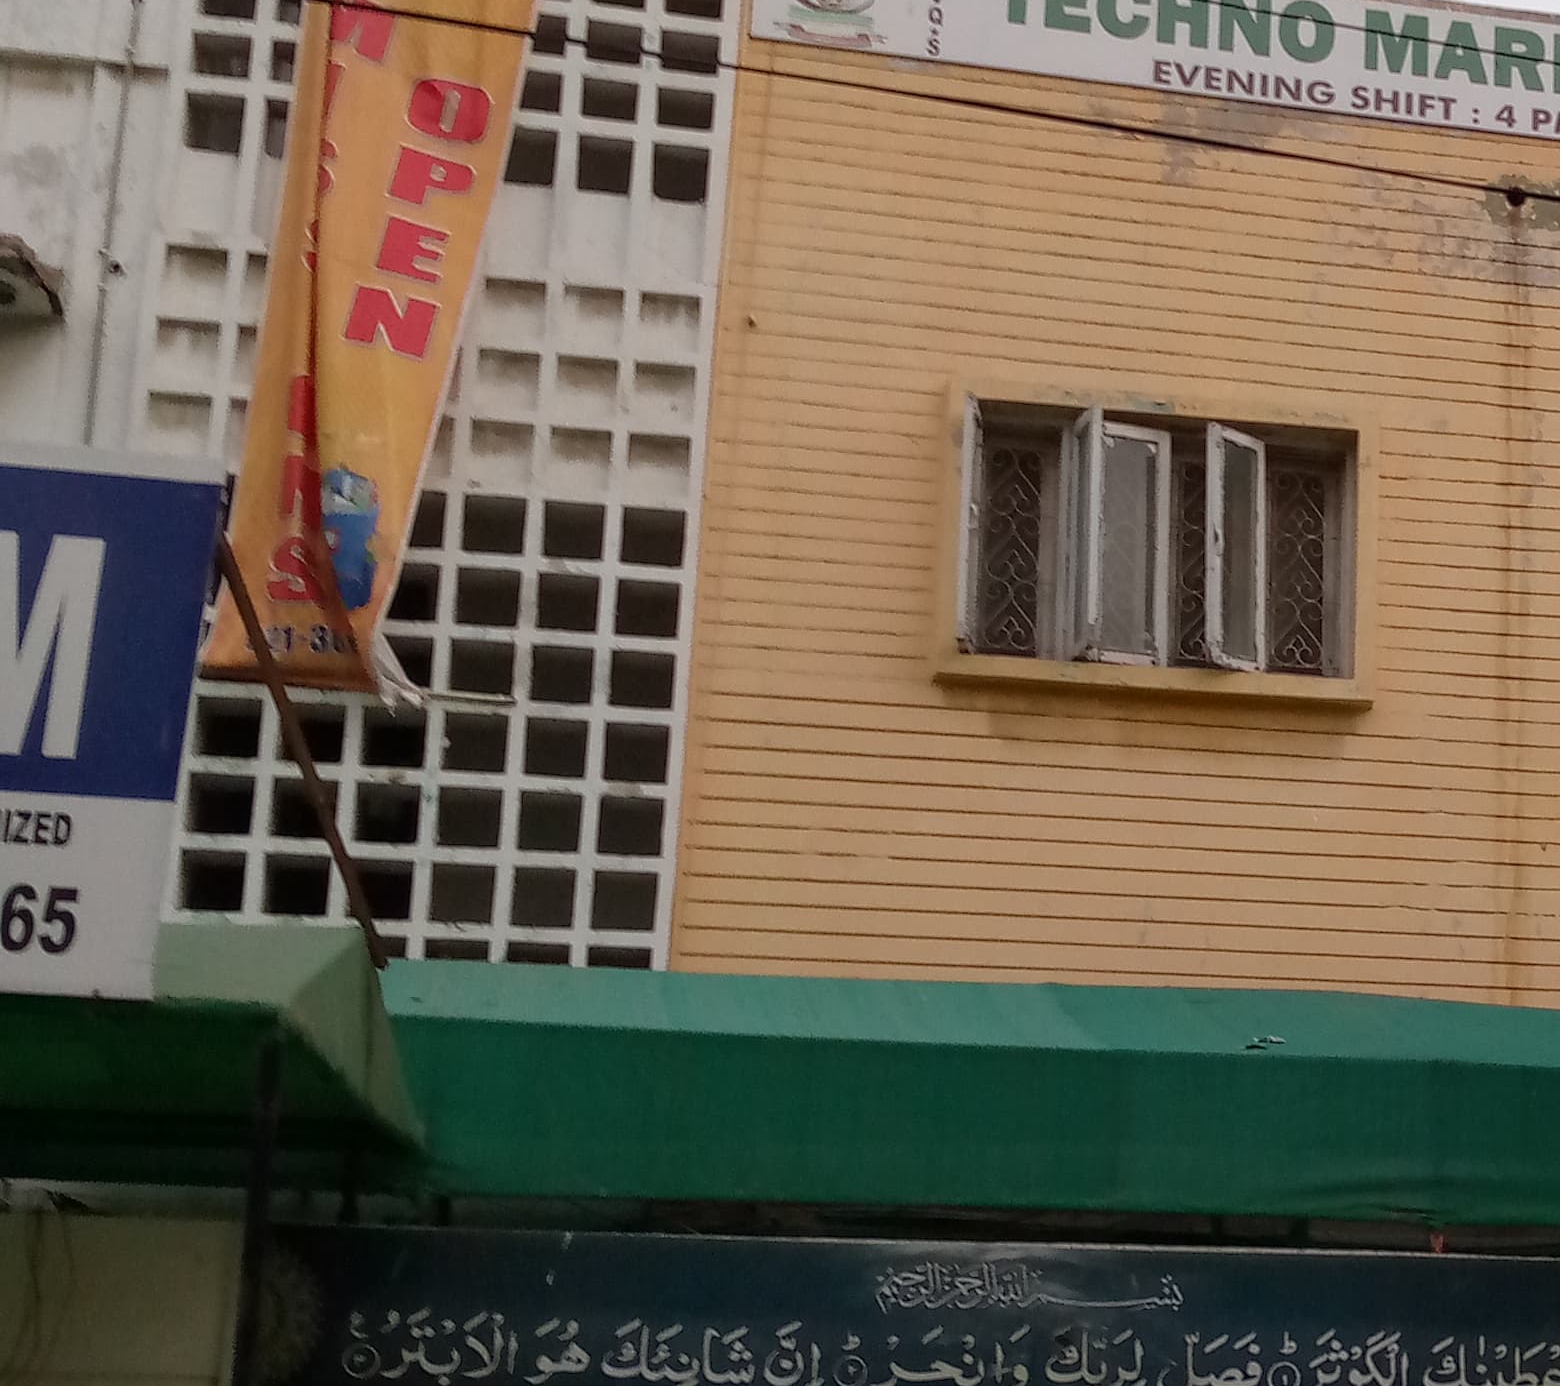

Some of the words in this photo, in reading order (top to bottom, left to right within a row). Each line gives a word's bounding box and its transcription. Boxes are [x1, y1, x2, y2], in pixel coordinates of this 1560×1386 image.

[1152, 59, 1335, 108] EVENING
[1350, 85, 1458, 122] SHIFT
[1495, 104, 1516, 130] 4
[342, 77, 495, 361] OPEN
